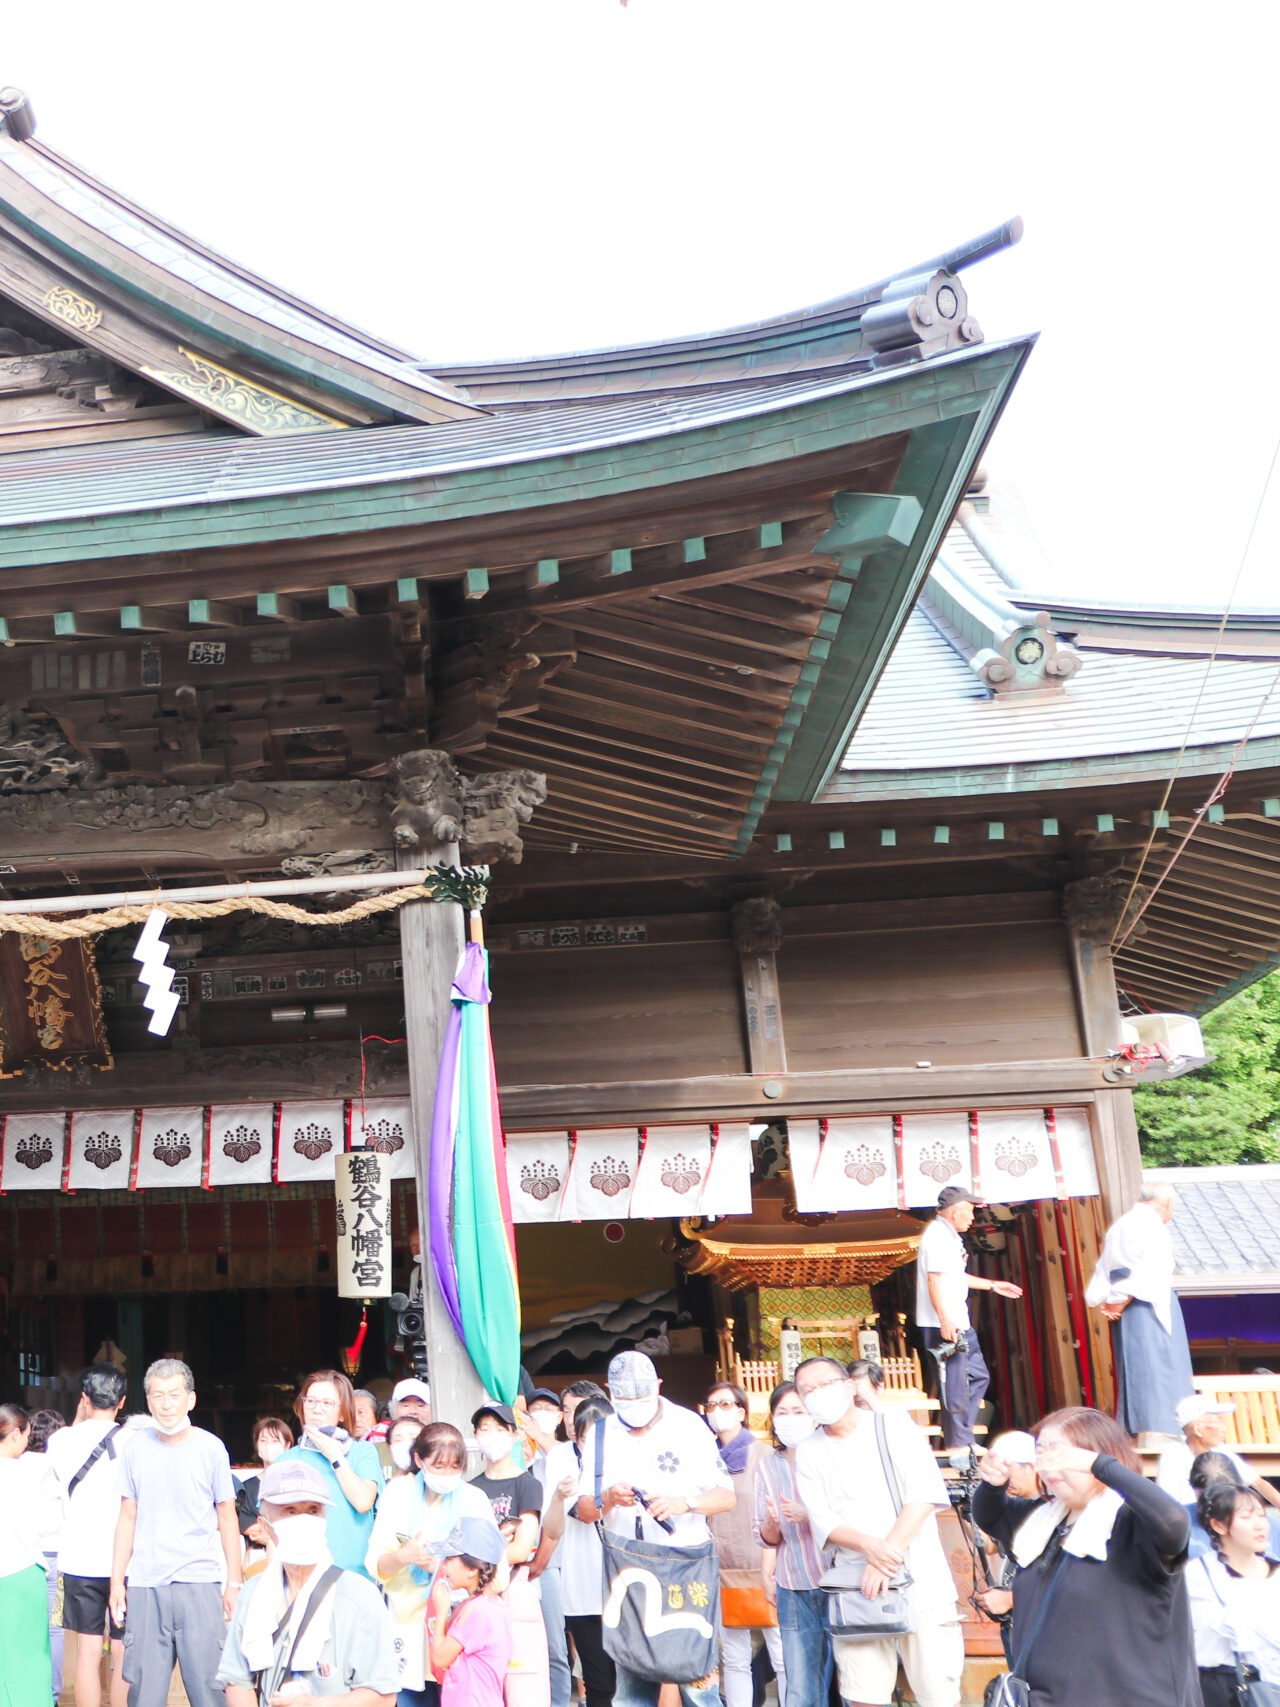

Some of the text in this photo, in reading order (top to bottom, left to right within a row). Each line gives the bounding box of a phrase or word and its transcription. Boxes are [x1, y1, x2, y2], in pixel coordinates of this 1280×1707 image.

[348, 1153, 383, 1288] 鶴谷八幡宮
[667, 1580, 711, 1610] 道楽
